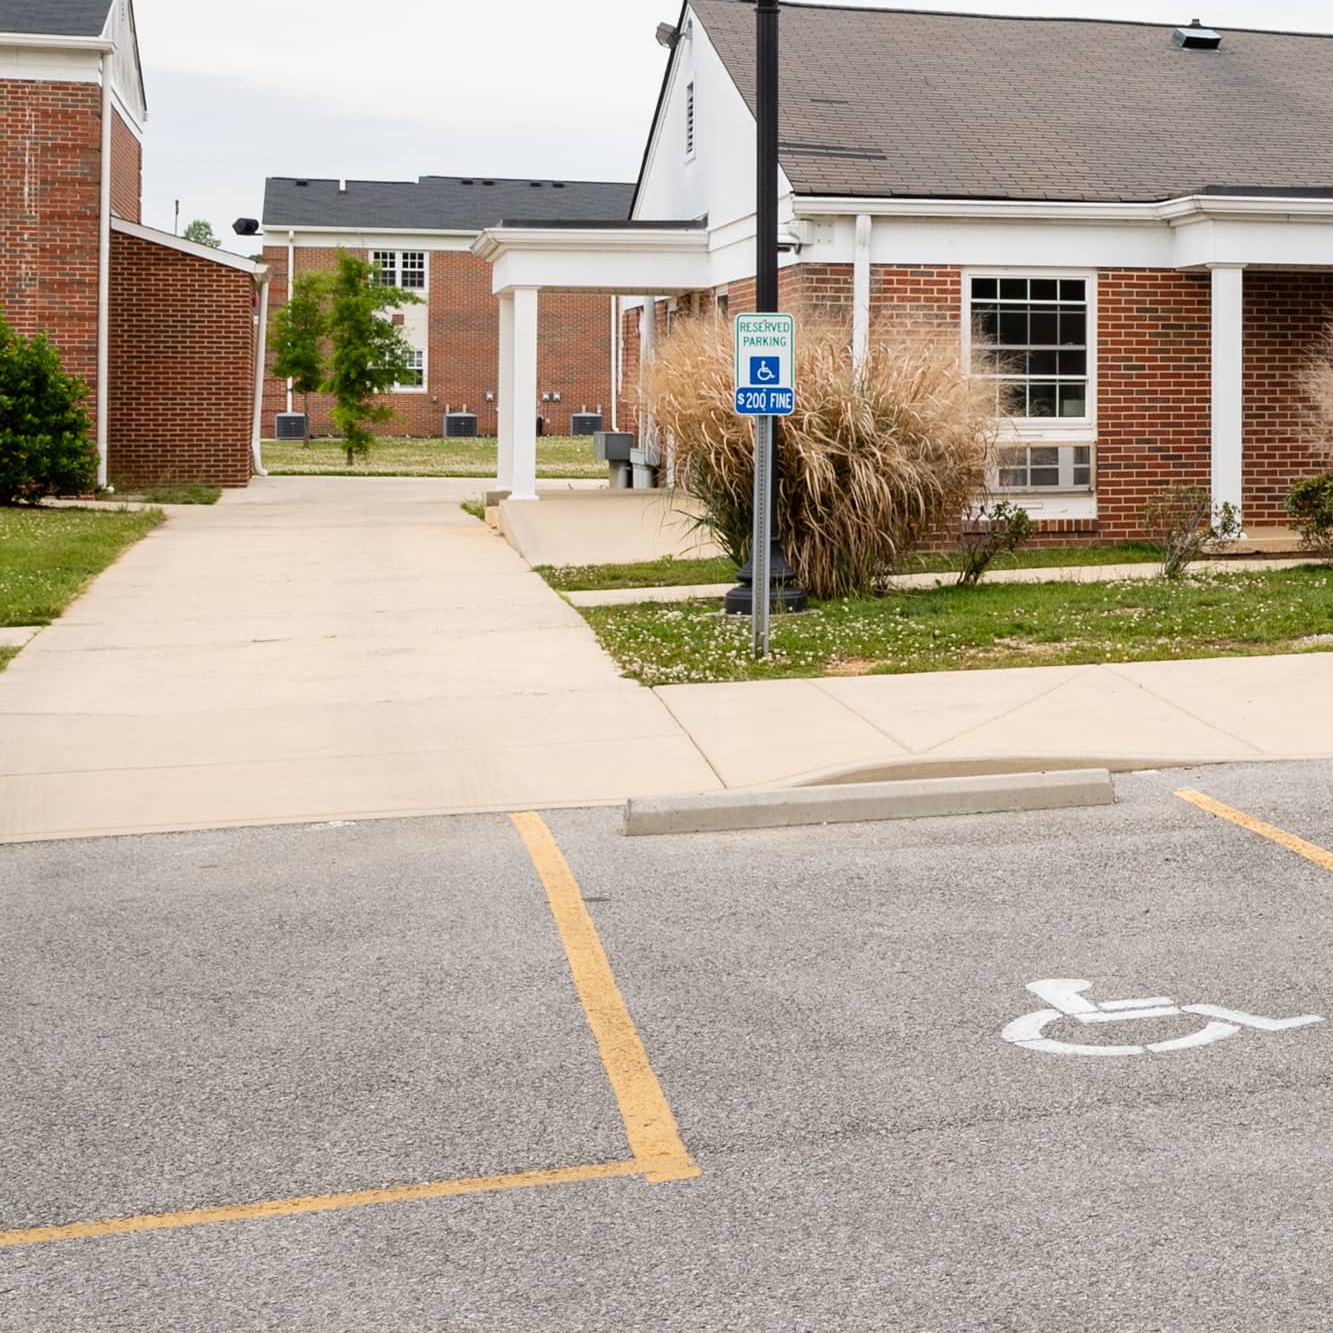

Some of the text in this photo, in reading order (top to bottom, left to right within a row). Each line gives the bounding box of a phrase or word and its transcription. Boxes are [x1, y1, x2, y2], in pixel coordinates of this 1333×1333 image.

[740, 322, 790, 332] RESERVED
[743, 337, 787, 347] PARKING
[770, 393, 791, 409] FINE
